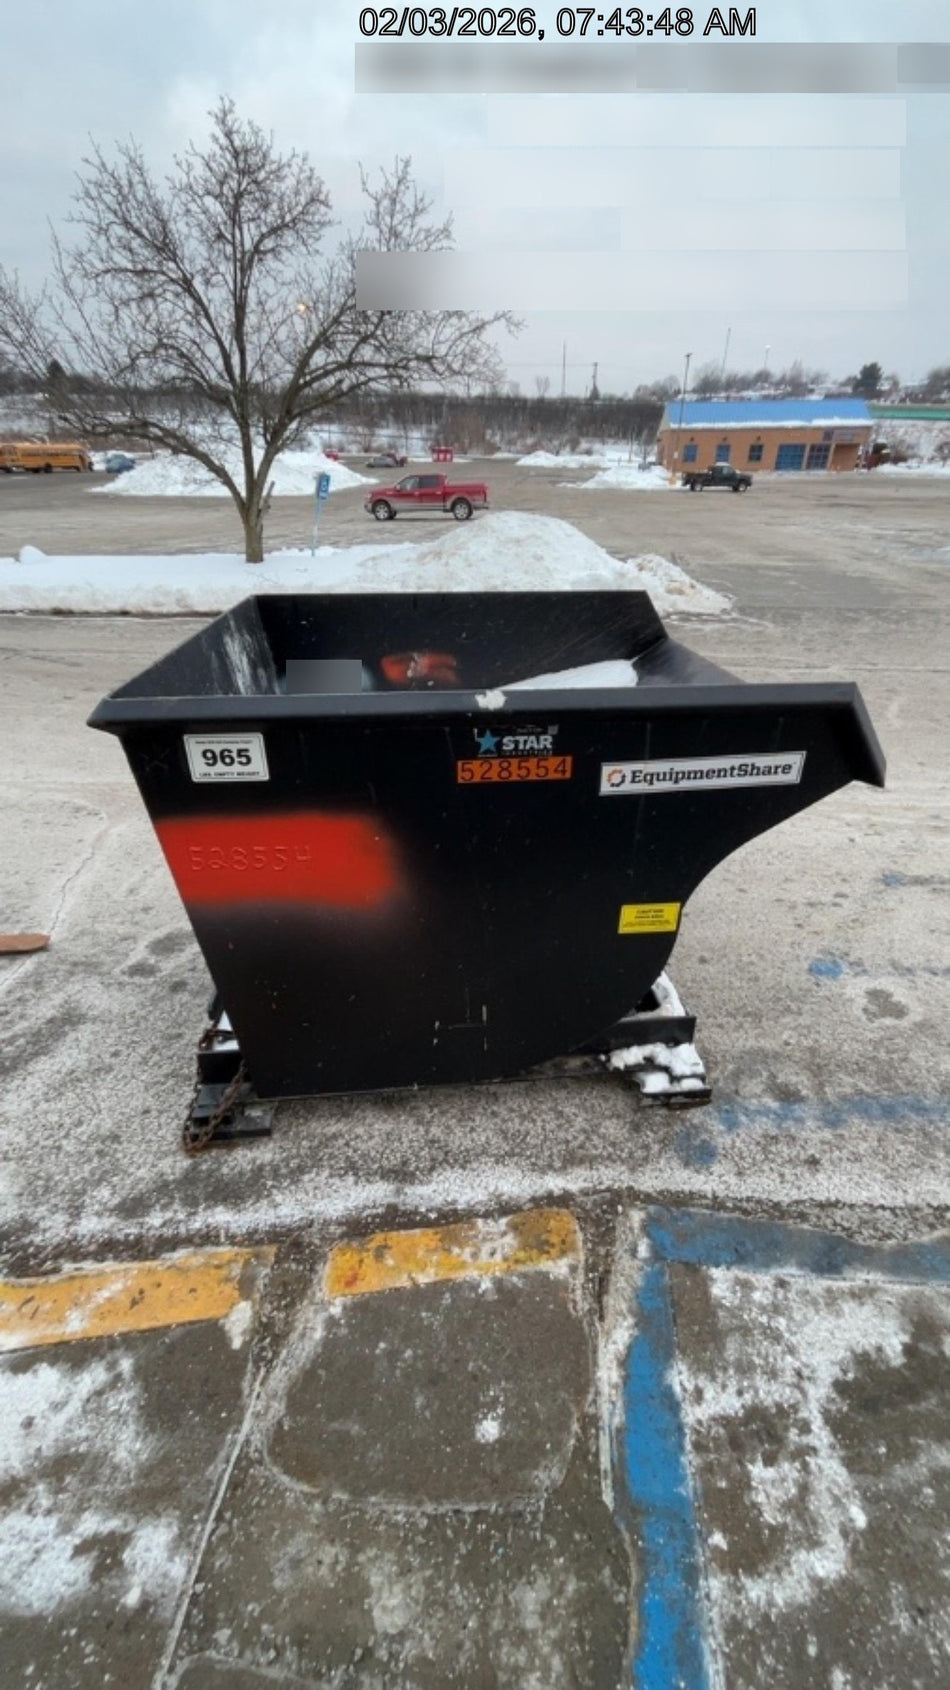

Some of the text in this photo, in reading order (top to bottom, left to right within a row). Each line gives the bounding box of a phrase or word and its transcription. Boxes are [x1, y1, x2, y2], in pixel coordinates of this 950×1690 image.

[502, 735, 553, 750] STAR
[202, 748, 252, 766] 965
[460, 757, 569, 782] 528554
[630, 763, 793, 786] EquipmentShare
[189, 845, 312, 871] 528554
